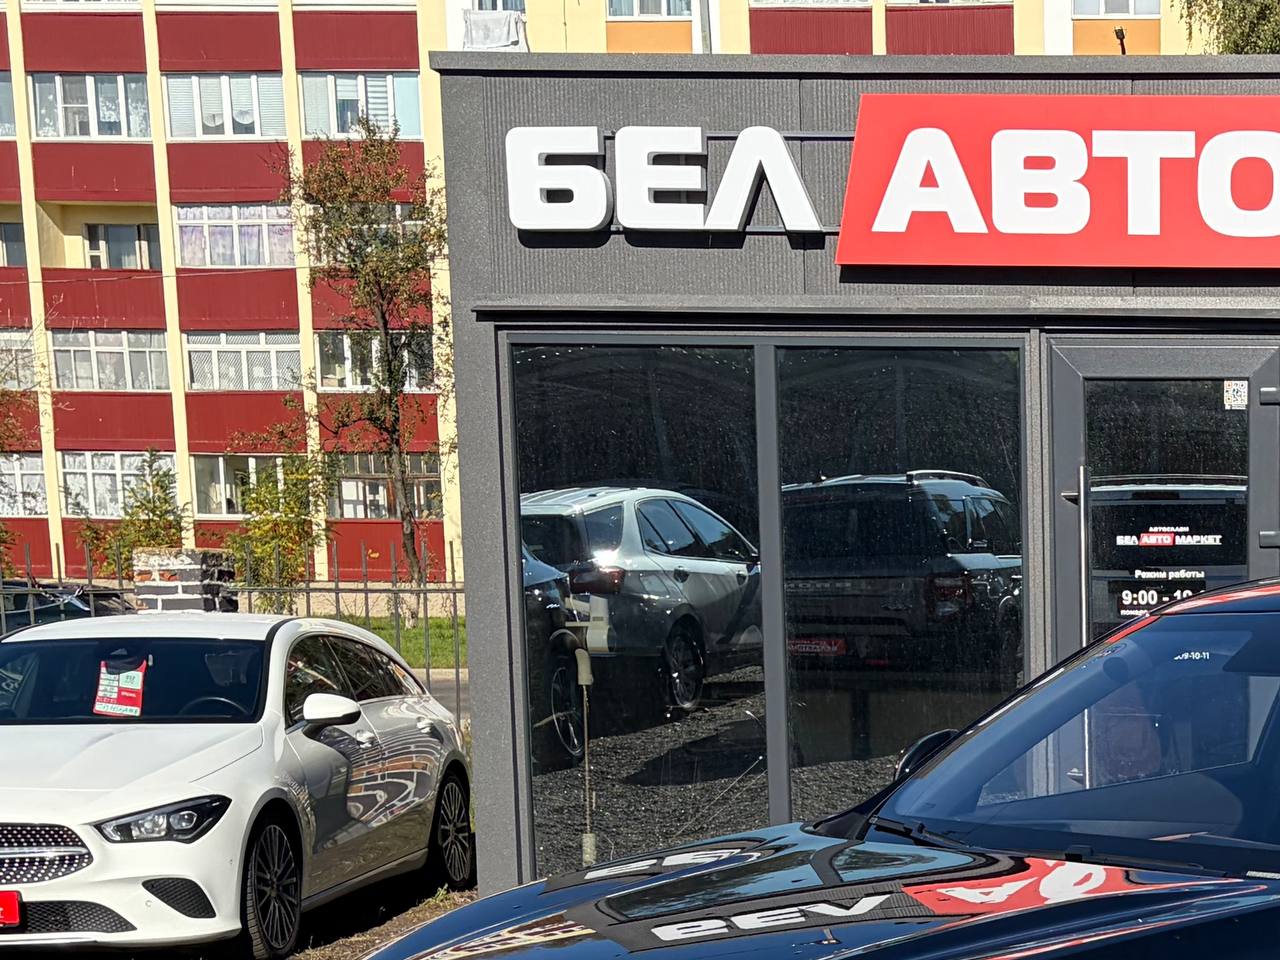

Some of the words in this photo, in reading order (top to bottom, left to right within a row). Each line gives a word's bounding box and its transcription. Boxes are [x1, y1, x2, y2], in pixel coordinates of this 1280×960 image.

[505, 125, 826, 232] БЕЛ
[1116, 535, 1139, 545] БЕЛ
[1141, 535, 1172, 544] АВТО
[1174, 535, 1222, 545] МАРКЕТ
[1134, 569, 1167, 579] Режим
[1168, 569, 1205, 580] работы
[1121, 589, 1158, 605] 9:00
